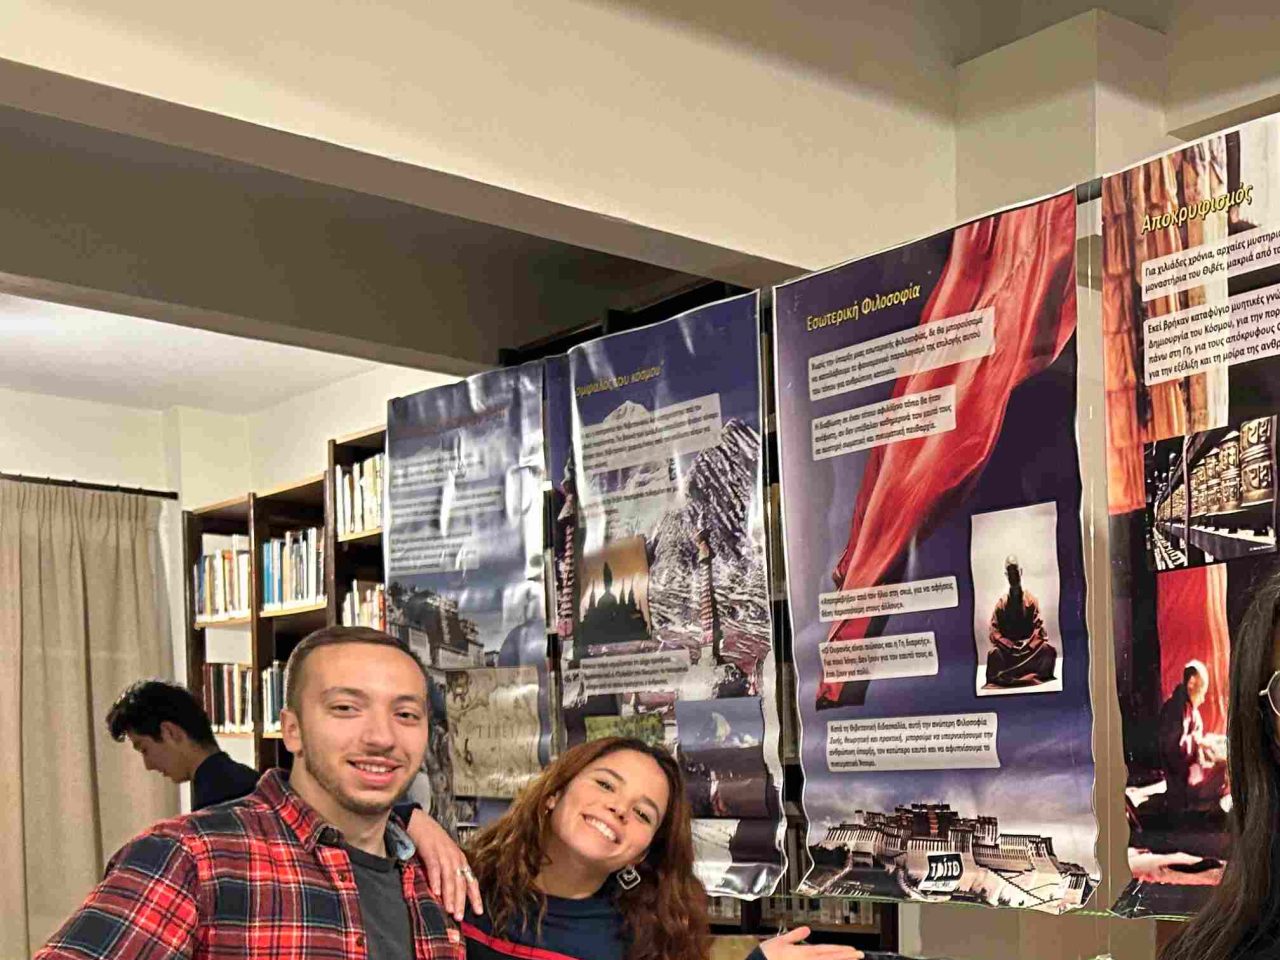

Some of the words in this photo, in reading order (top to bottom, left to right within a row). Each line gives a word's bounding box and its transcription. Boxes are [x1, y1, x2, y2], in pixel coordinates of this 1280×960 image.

[1141, 183, 1254, 235] Αποκρυφισμός
[1145, 267, 1156, 277] Για
[1217, 241, 1245, 257] αρχαίες
[1227, 254, 1254, 270] μακριά
[1255, 247, 1272, 260] από
[806, 300, 859, 332] Εσωτερική
[861, 282, 921, 315] Φιλοσοφία
[1191, 305, 1229, 322] καταφύγιο
[1250, 312, 1263, 323] την
[1208, 337, 1224, 349] τους
[1225, 324, 1275, 344] απόκρυφους
[1222, 346, 1245, 361] μοίρα
[1246, 343, 1259, 355] της
